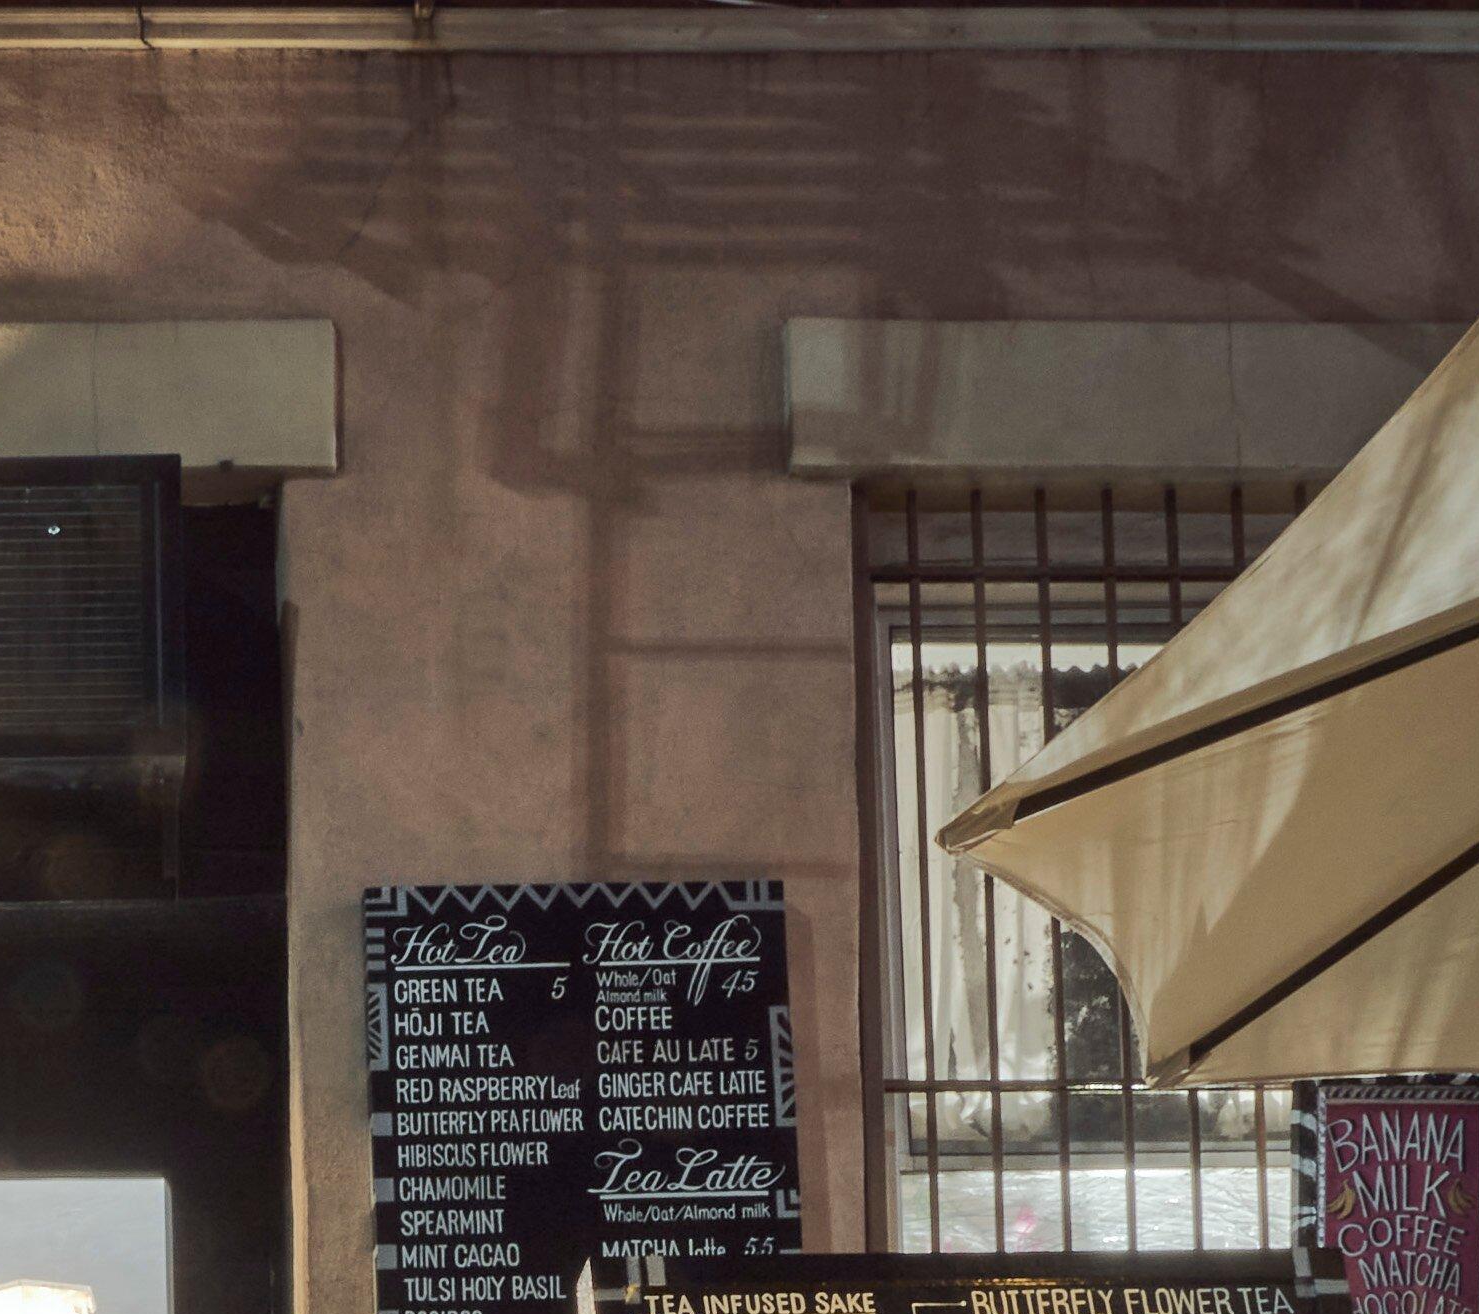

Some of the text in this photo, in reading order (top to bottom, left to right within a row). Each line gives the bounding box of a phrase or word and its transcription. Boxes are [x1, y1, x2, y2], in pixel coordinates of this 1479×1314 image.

[391, 916, 526, 964] Hot Tea
[582, 915, 762, 1006] Hot Coffee
[394, 976, 569, 1003] GREEN TEA 5
[596, 968, 677, 987] Whole/Oat
[595, 989, 667, 1003] Almond milk
[451, 1011, 490, 1035] TEA
[595, 1006, 672, 1031] COFFEE
[396, 1044, 515, 1070] GENMAI TEA
[597, 1038, 759, 1064] CAFE AU LATE 5
[396, 1076, 581, 1103] RED RASPBERRY Leaf
[598, 1070, 766, 1098] GINGER CAFE LATTE
[397, 1108, 584, 1136] BUTTERFLY PEA FLOWER
[599, 1104, 769, 1132] CATECHIN COFFEE
[398, 1142, 548, 1168] HIBISCUS FLOWER
[1327, 1110, 1465, 1174] BANANA
[587, 1138, 785, 1193] Tea Latte
[399, 1176, 506, 1201] CHAMOMILE
[1352, 1162, 1450, 1218] MILK
[401, 1209, 504, 1236] SPEARMINT
[743, 1203, 770, 1218] milk
[602, 1240, 680, 1257] MATCHA
[1338, 1214, 1465, 1257] COFFEE
[402, 1243, 520, 1268] MINT CACAO
[1358, 1250, 1462, 1296] MATCHA
[404, 1276, 566, 1302] TULSI HOLY BASIL
[1237, 1287, 1295, 1314] TEA
[815, 1292, 876, 1314] SAKE
